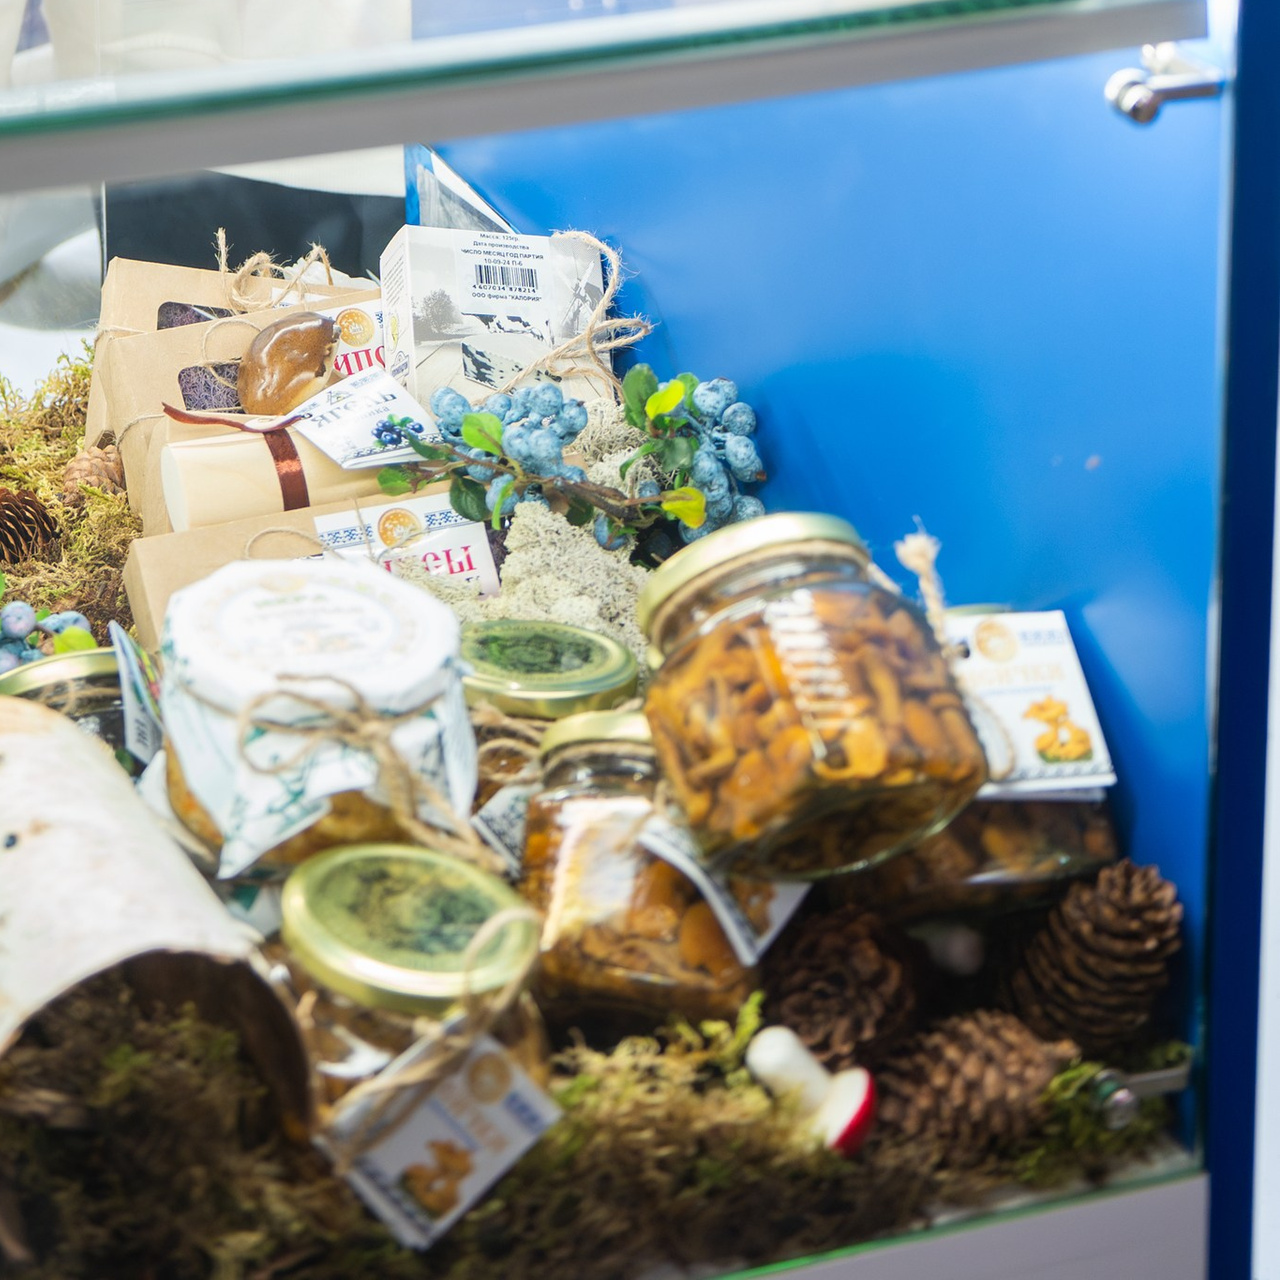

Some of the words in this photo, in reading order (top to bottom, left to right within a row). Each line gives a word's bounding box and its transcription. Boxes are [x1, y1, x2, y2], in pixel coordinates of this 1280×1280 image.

[488, 242, 530, 251] производства
[461, 248, 482, 256] ЧИСЛО
[483, 250, 505, 258] МЕСЯЦ
[487, 293, 507, 301] фирма
